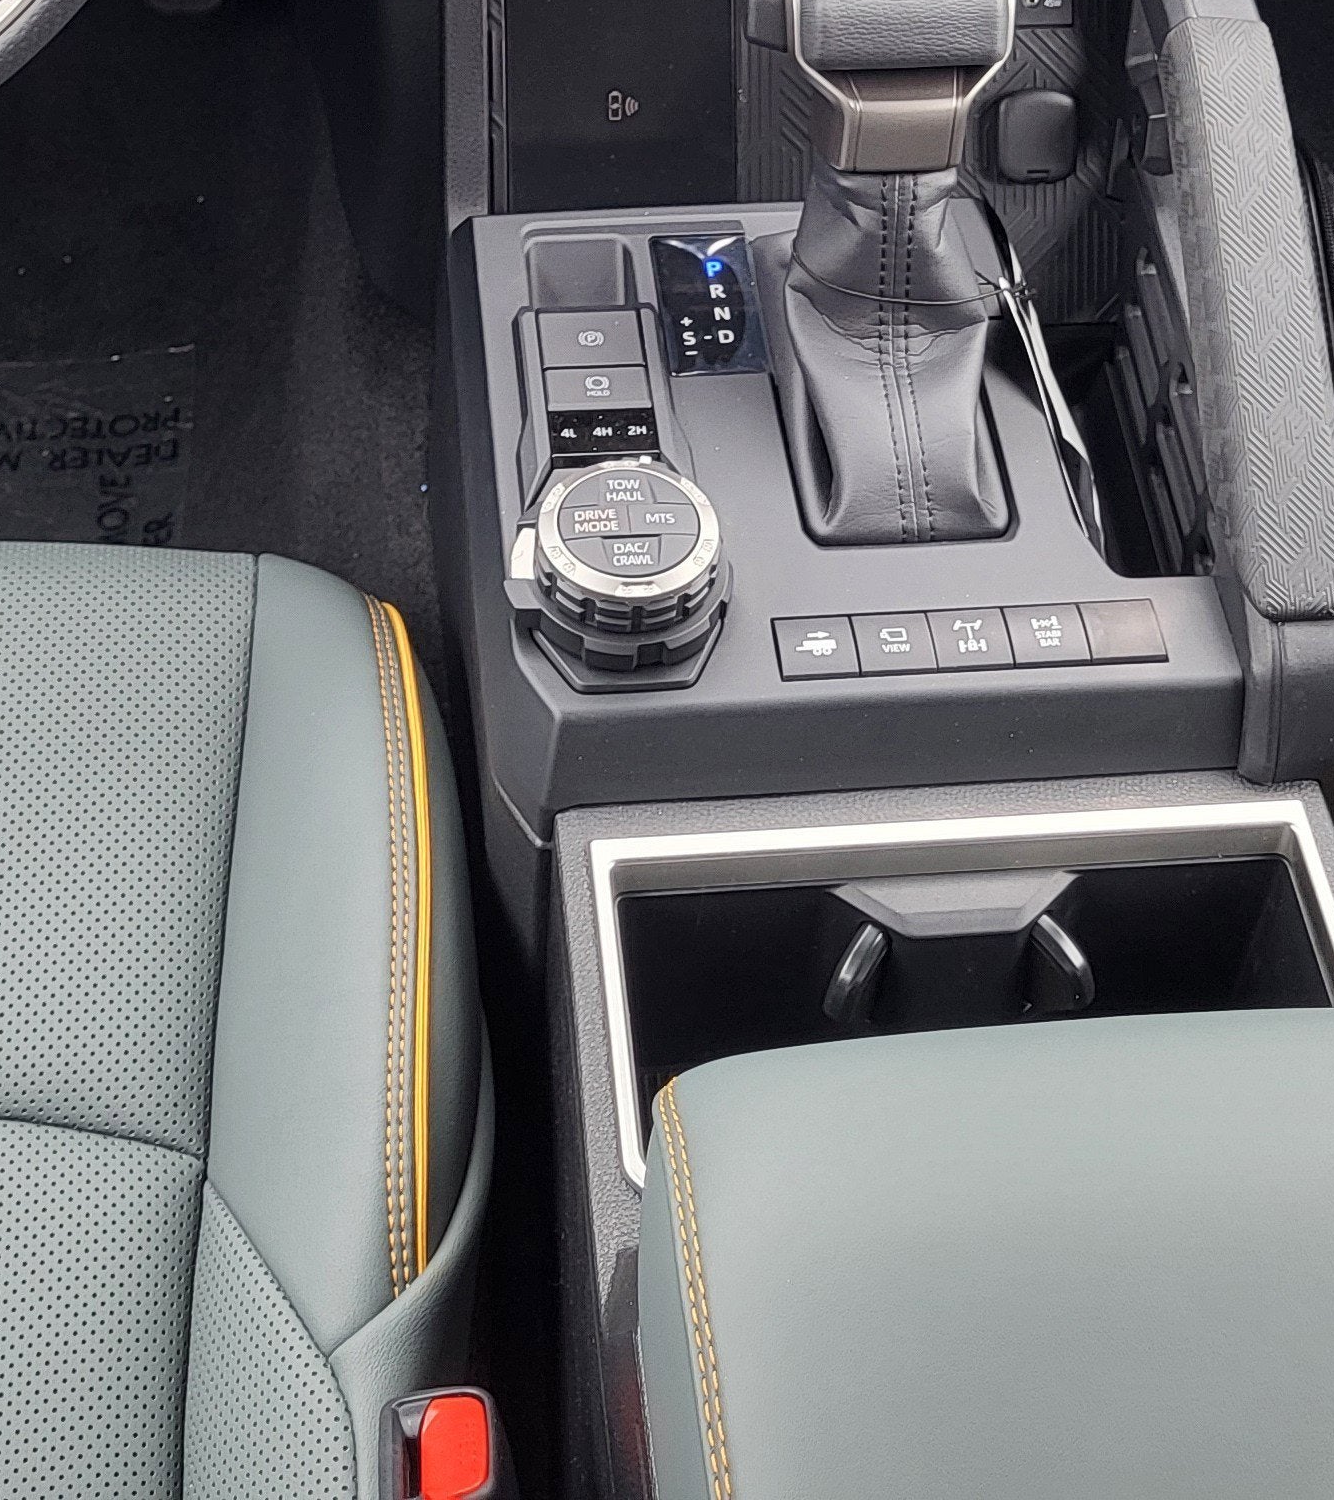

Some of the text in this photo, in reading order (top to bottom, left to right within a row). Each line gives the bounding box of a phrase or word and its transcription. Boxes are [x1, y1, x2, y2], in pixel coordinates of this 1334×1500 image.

[704, 260, 723, 278] P
[710, 284, 727, 299] R
[714, 307, 731, 321] N
[682, 330, 735, 346] S D
[586, 389, 611, 398] HOLD
[561, 425, 647, 438] 4L 4H 2H
[48, 440, 180, 472] DEALER
[606, 479, 640, 491] TOW
[606, 489, 645, 501] HAUL
[574, 509, 617, 521] DRIVE
[645, 512, 676, 524] MTS
[575, 520, 619, 532] MODE
[613, 542, 649, 555] DAC/
[613, 554, 654, 566] CRAWL
[882, 643, 910, 653] VIEW
[1039, 637, 1061, 647] BAR
